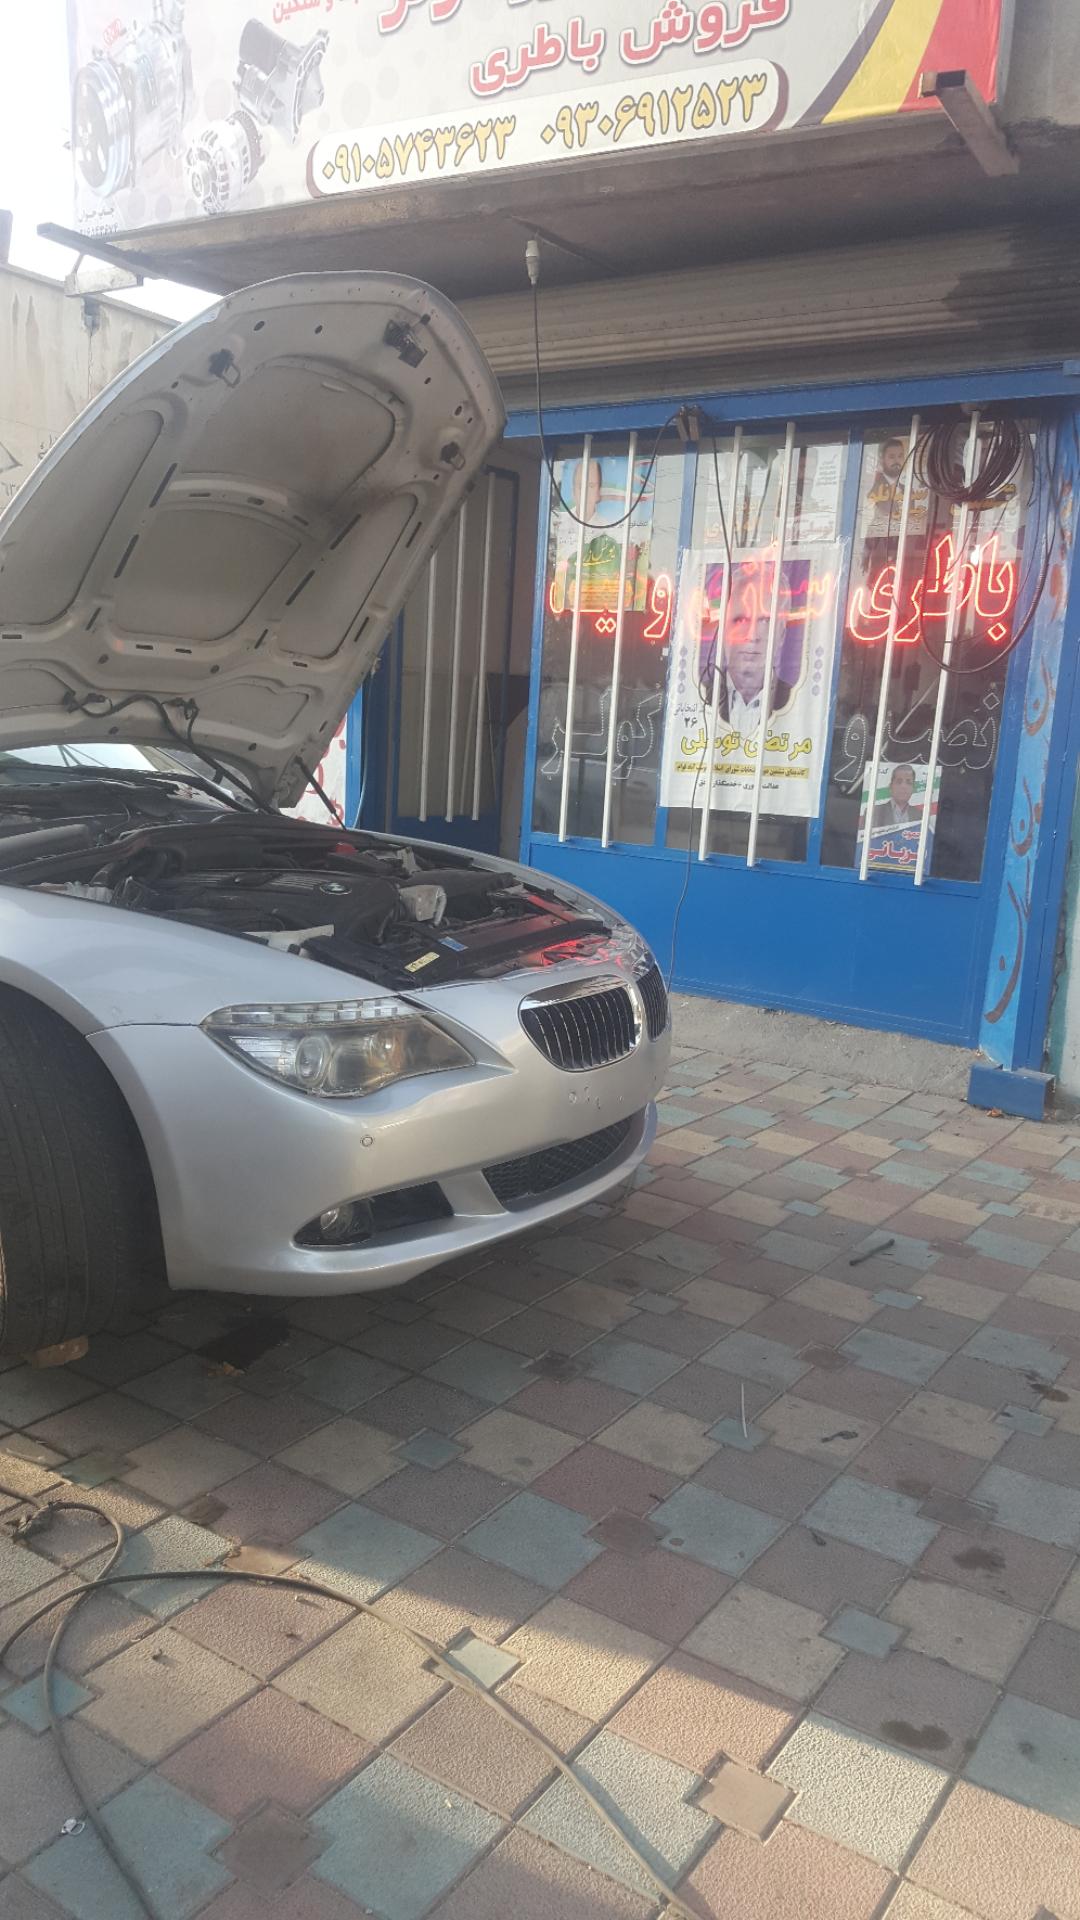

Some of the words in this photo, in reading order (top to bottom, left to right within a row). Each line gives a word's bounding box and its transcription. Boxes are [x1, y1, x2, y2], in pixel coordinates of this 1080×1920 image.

[470, 17, 603, 96] باطری
[540, 72, 768, 149] ۰۹۳۰۶۹۱۲۵۲۳
[322, 114, 516, 184] ۰۹۱۰۵۷۴۳۶۲۳
[850, 533, 1014, 642] باطری
[683, 717, 698, 729] ۲۶
[743, 729, 813, 762] مرتضی
[743, 783, 755, 791] وری
